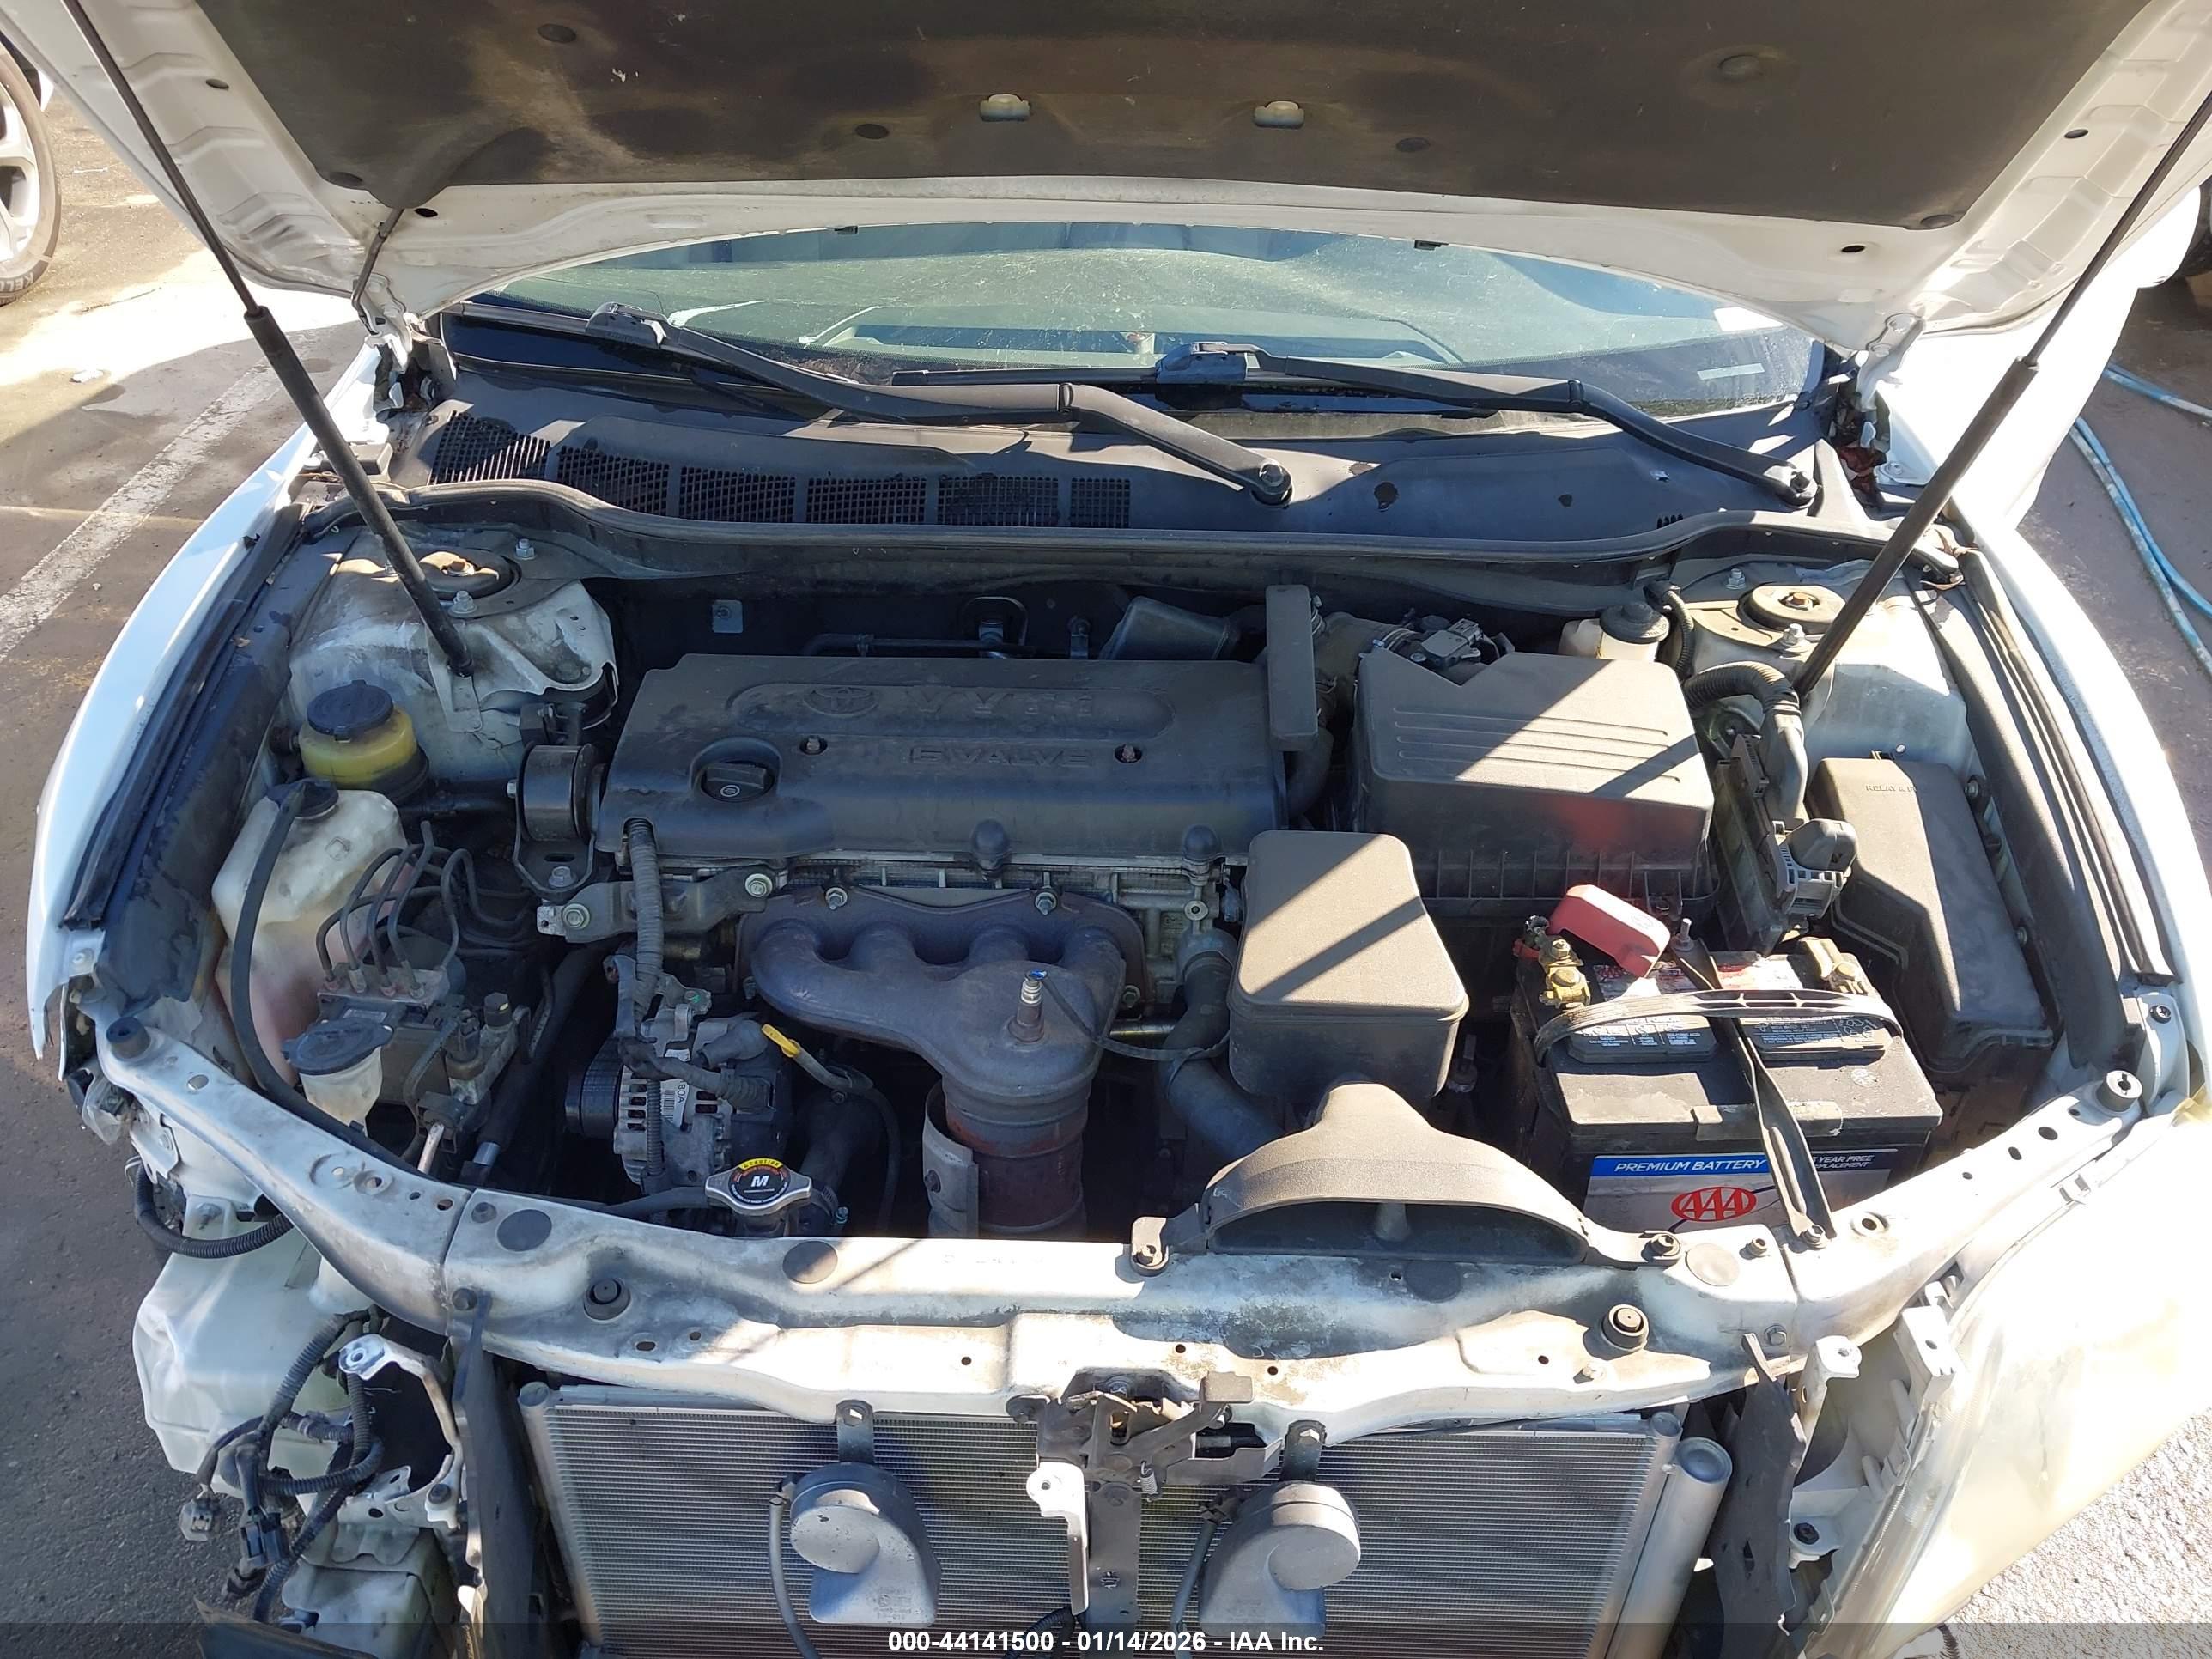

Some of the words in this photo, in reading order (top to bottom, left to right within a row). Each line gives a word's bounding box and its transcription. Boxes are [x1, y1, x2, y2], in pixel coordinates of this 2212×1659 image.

[1865, 783, 1896, 792] RELAY
[1614, 1161, 1690, 1172] PREMIUM
[1691, 1159, 1767, 1170] BATTERY
[750, 1175, 769, 1187] M
[1672, 1186, 1756, 1221] AAA
